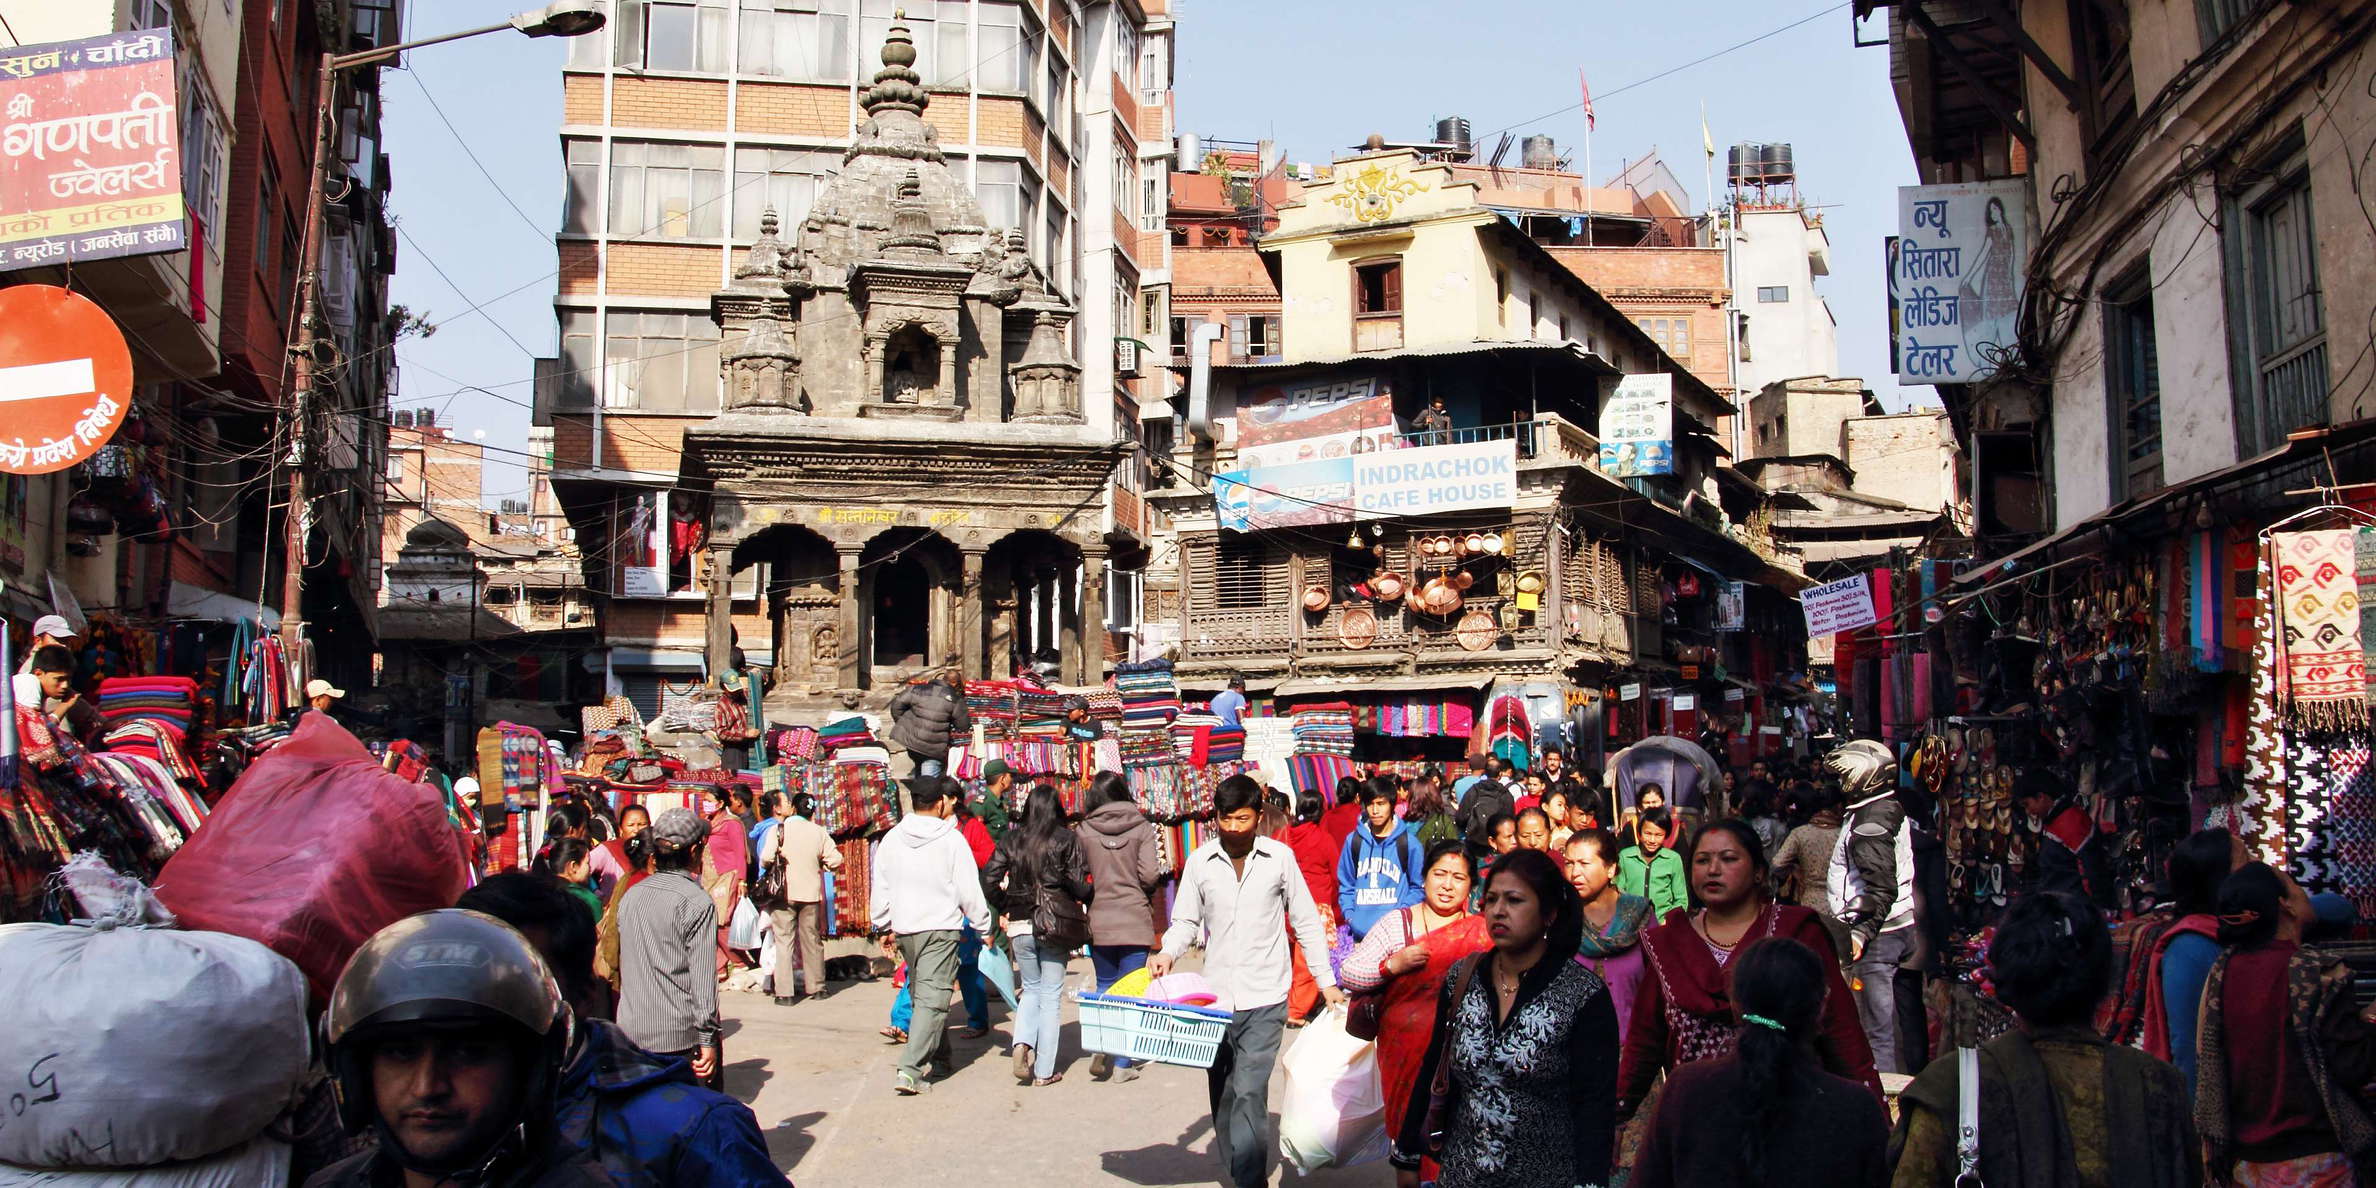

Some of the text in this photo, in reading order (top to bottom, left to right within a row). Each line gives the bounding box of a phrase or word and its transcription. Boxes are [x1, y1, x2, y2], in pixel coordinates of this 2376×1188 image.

[3, 91, 175, 160] गणपती
[5, 93, 35, 120] श्री
[48, 148, 173, 198] ज्वेलर्स
[1914, 200, 1951, 238] न्यू
[14, 240, 66, 262] न्यूरोड
[1902, 238, 1961, 281] सितारा
[1904, 286, 1960, 329] लेडिज
[1906, 336, 1958, 377] टेलर
[1289, 377, 1376, 410] PEPSI
[32, 434, 78, 466] प्रवेश
[75, 393, 120, 447] निषेध
[1359, 455, 1510, 486] INDRACHOK
[1362, 482, 1507, 510] CAFE HOUSE
[1803, 577, 1860, 600] WHOLESALE
